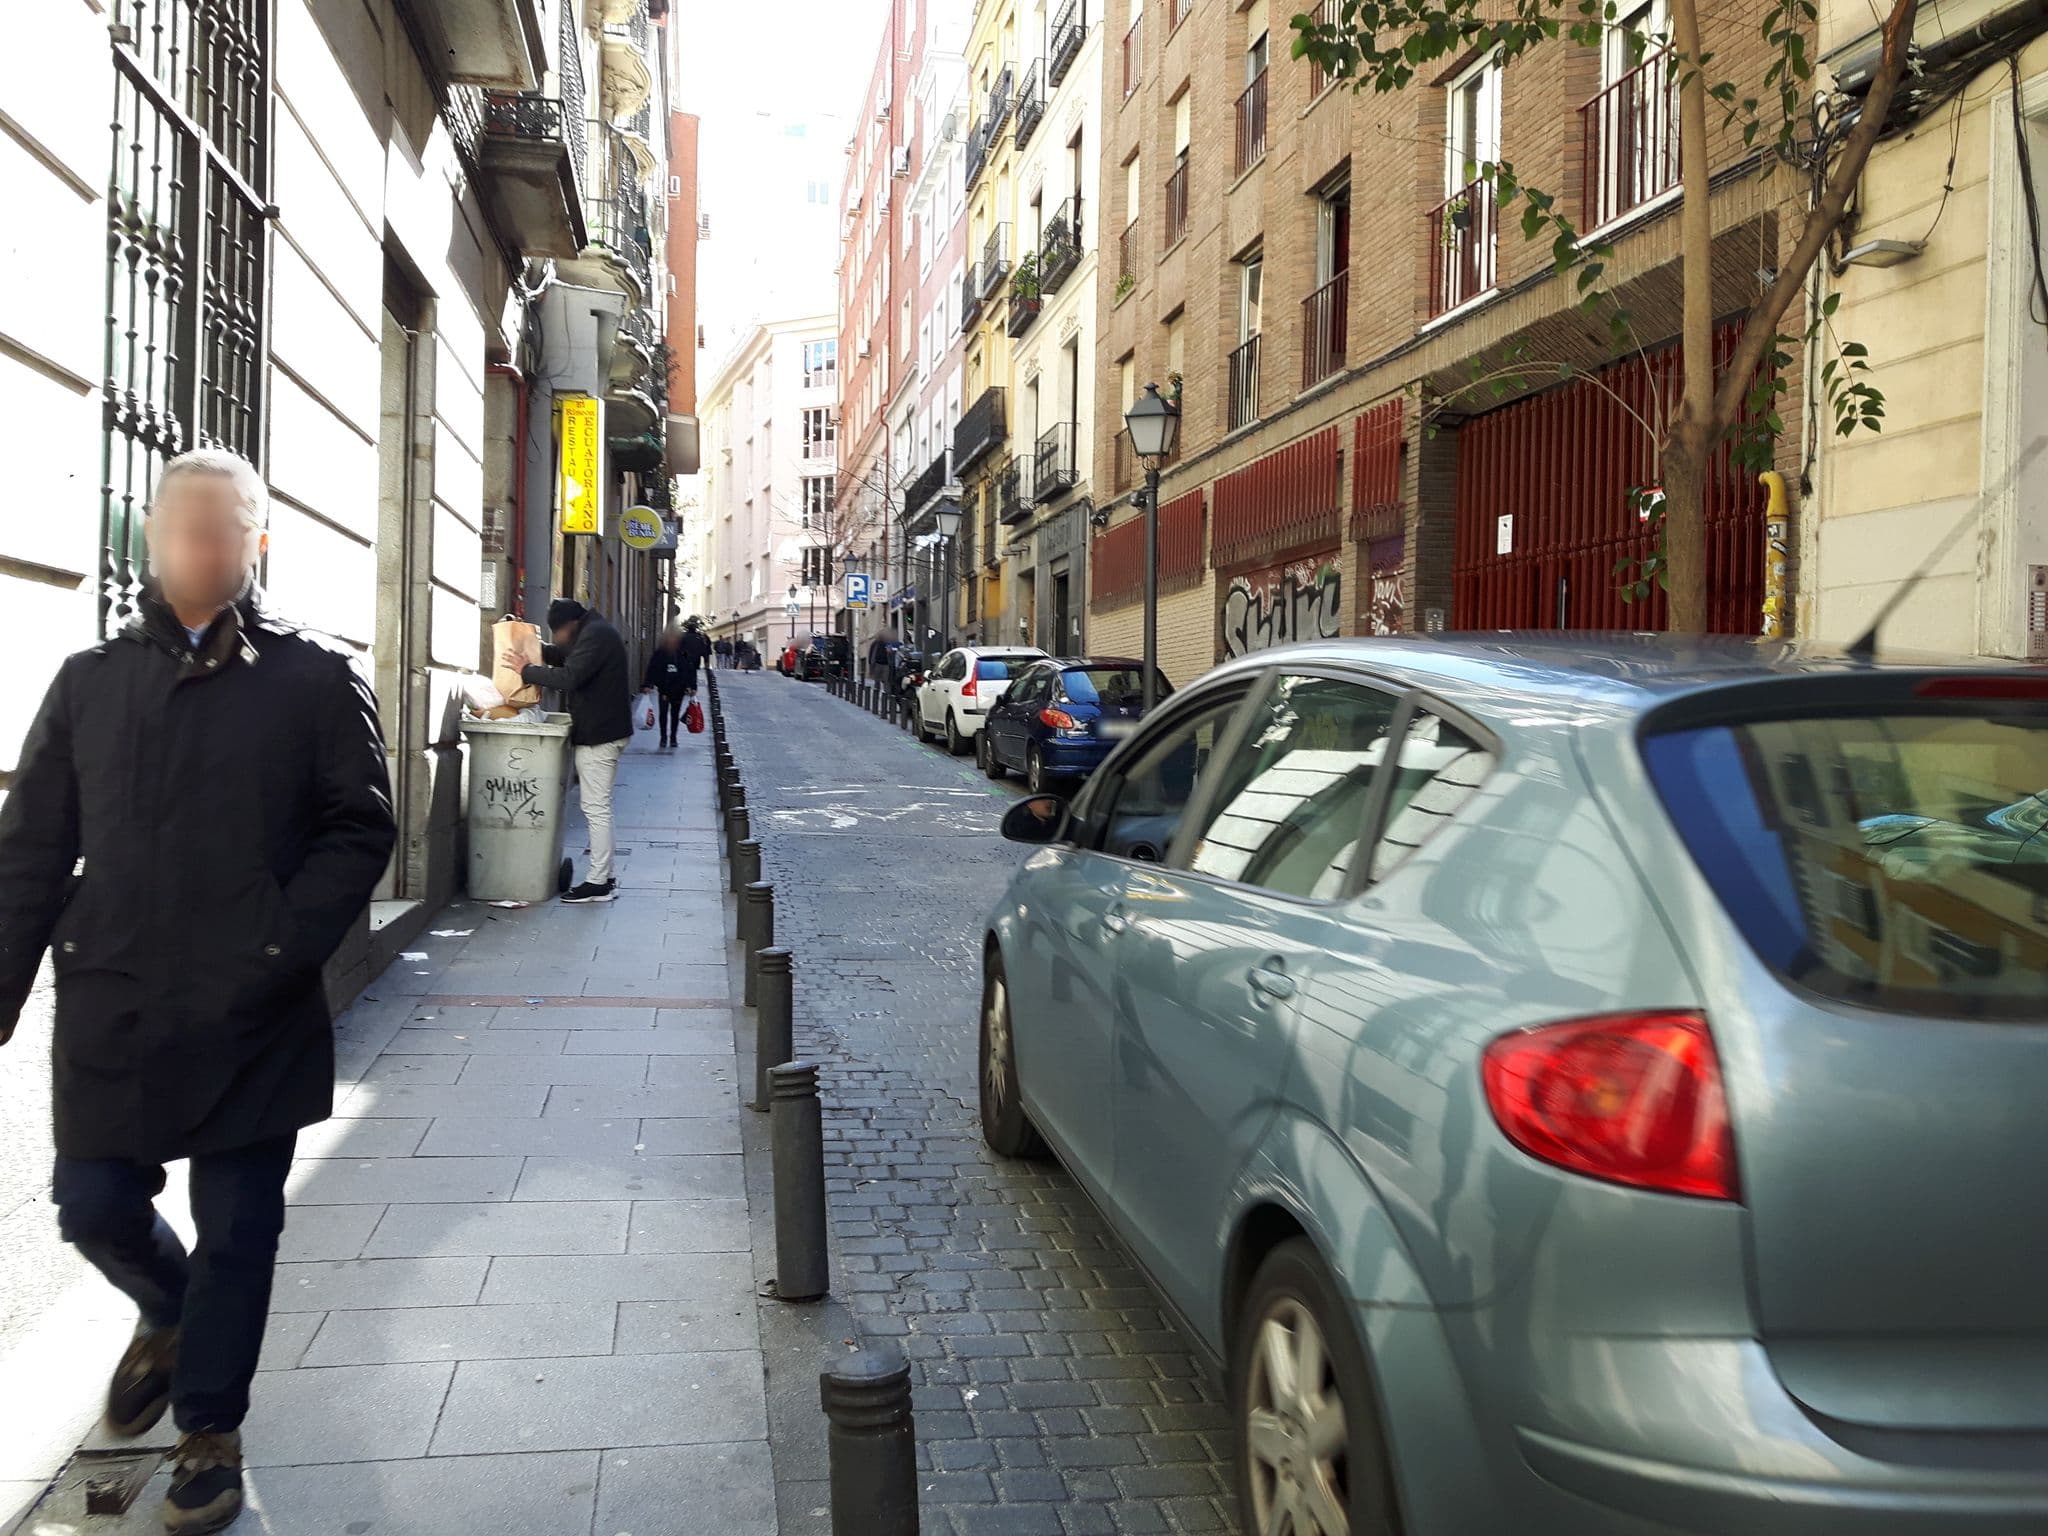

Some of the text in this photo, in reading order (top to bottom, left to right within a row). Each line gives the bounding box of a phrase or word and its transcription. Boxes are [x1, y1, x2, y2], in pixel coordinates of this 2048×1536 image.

[567, 416, 576, 529] RESTAUN
[584, 416, 594, 530] ECUATORIANO
[848, 576, 866, 598] P
